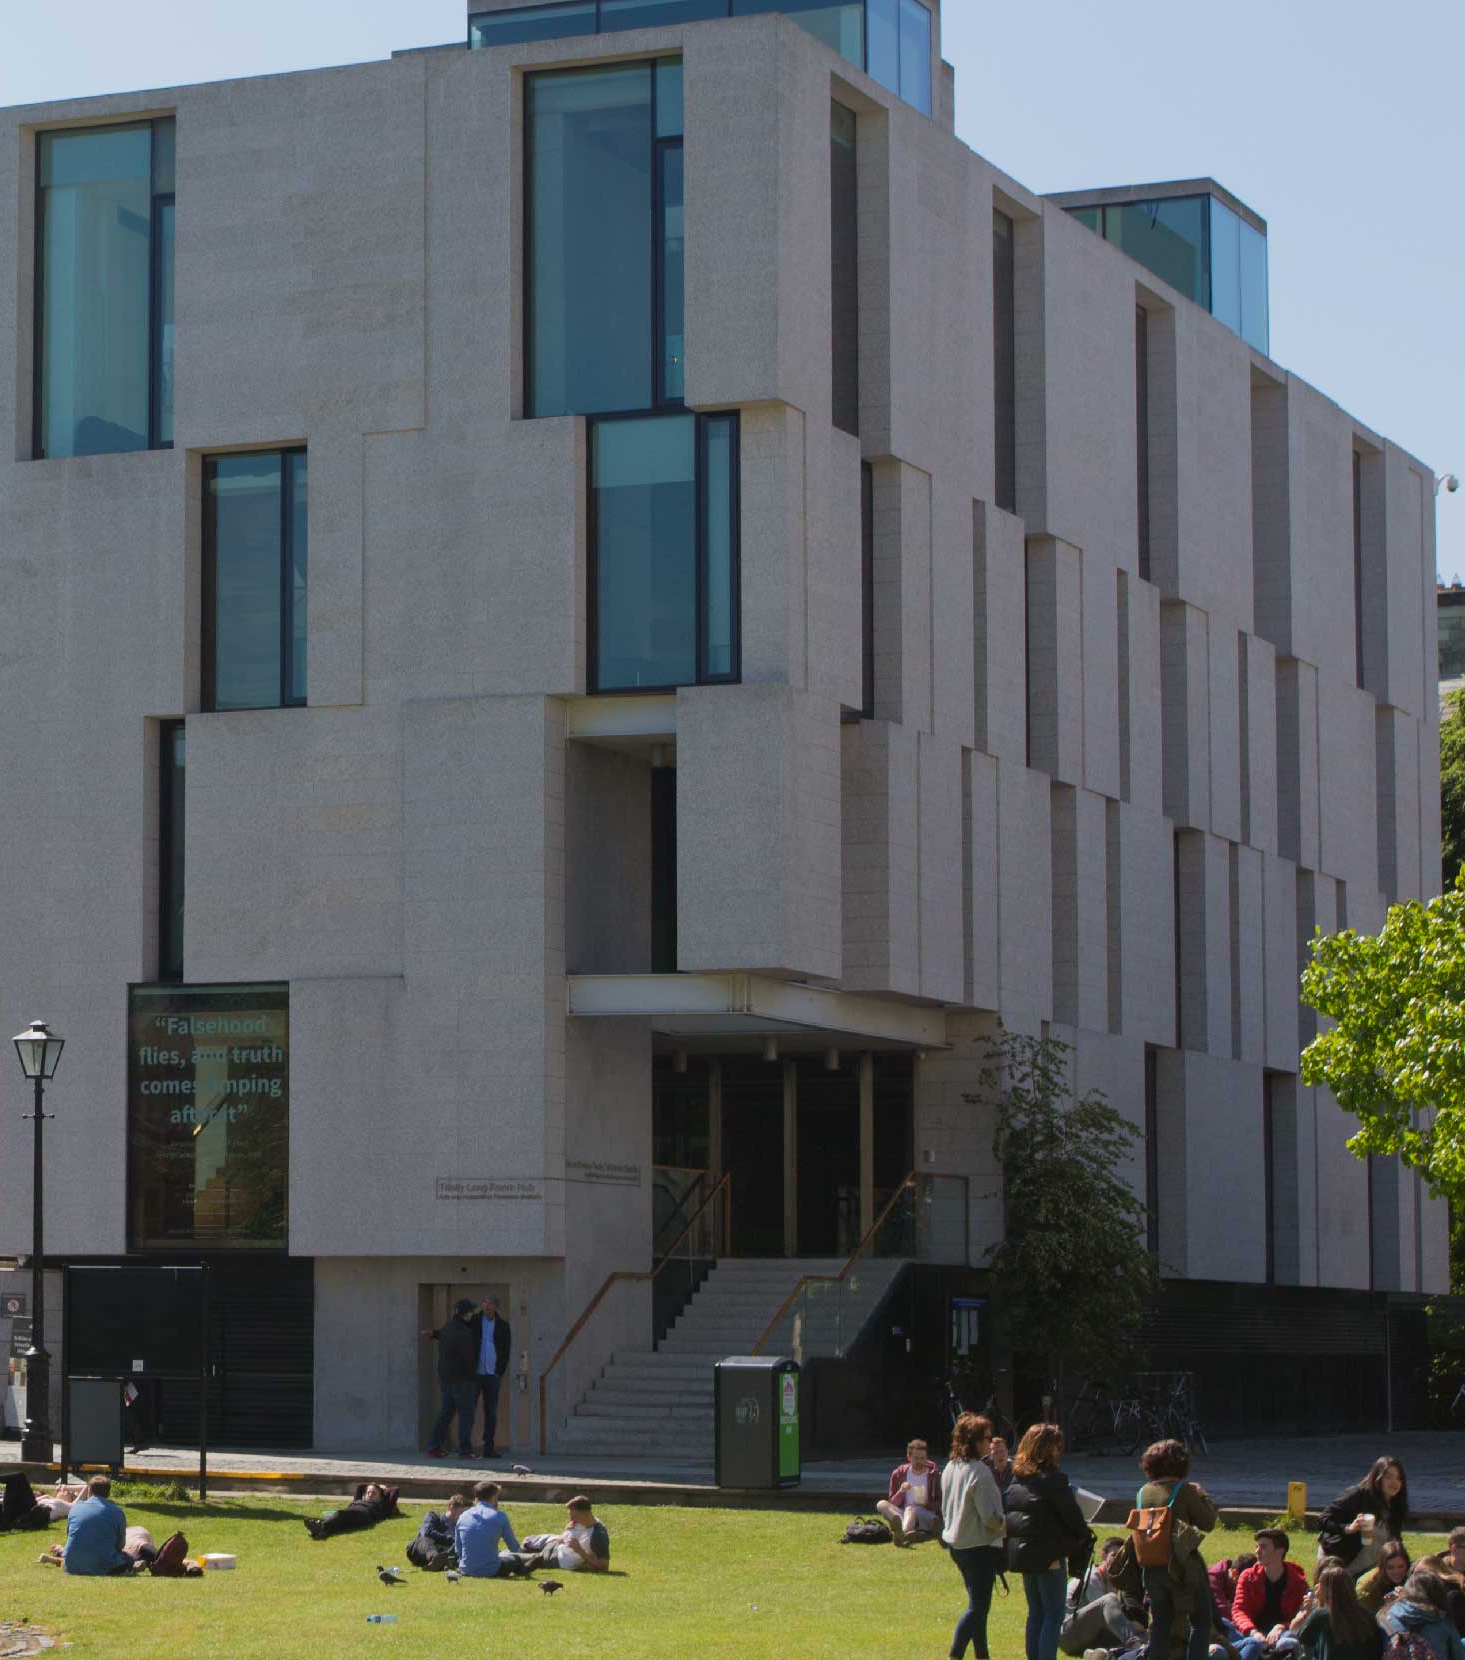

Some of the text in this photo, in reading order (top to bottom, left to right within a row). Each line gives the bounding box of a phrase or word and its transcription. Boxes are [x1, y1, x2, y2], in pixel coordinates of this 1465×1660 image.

[139, 1045, 283, 1068] flies, and truth
[140, 1072, 282, 1097] comes lmping
[170, 1104, 215, 1124] after
